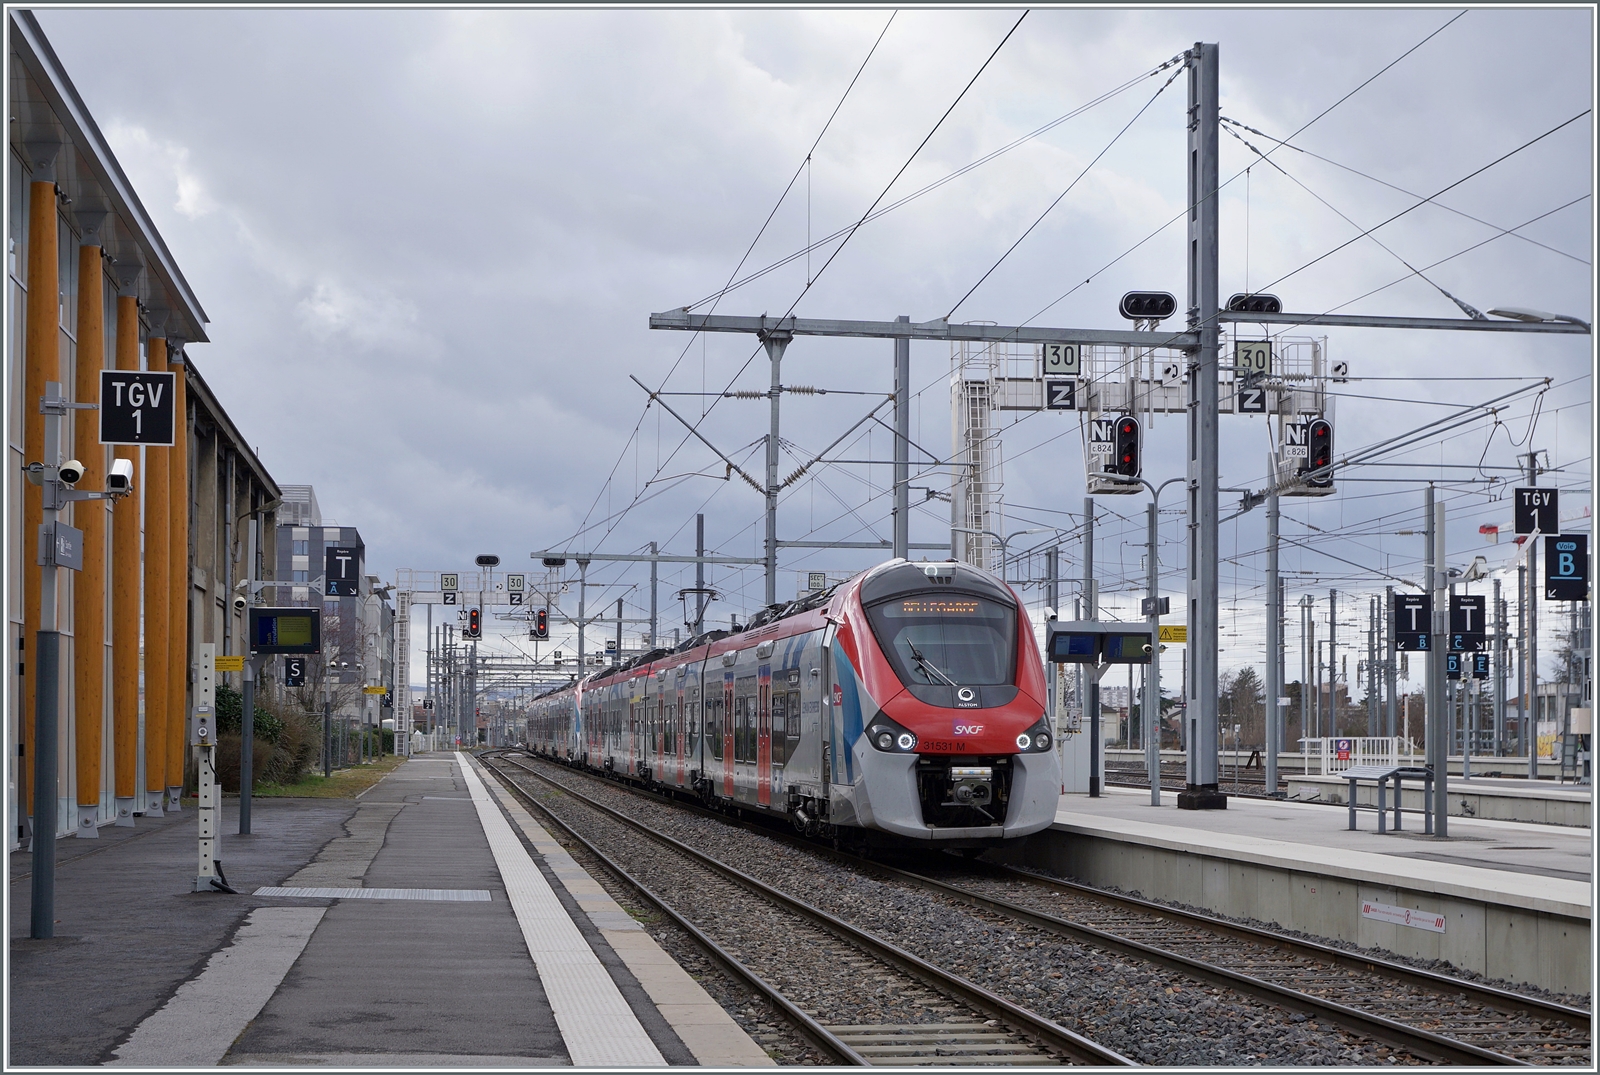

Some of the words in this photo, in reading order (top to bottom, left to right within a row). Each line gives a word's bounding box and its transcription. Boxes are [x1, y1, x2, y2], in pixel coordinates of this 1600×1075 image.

[1050, 345, 1074, 366] 30
[1242, 349, 1266, 370] 30
[111, 381, 164, 408] TGV
[1052, 385, 1071, 406] Z
[1243, 388, 1261, 409] Z
[131, 408, 142, 434] 1
[1091, 421, 1113, 441] Nf
[1286, 424, 1307, 445] Nf
[1522, 492, 1551, 506] TGV
[1529, 508, 1539, 529] 1
[335, 555, 352, 579] T
[1559, 552, 1576, 576] B
[330, 585, 338, 593] A
[443, 577, 456, 587] 30
[510, 578, 522, 588] 30
[445, 594, 454, 604] Z
[512, 594, 521, 604] Z
[1404, 604, 1423, 631] T
[1459, 605, 1478, 632] T
[1418, 639, 1427, 648] B
[1454, 639, 1463, 648] C
[290, 662, 301, 677] S
[1448, 660, 1457, 670] D
[1478, 661, 1485, 670] E
[384, 692, 391, 700] R
[954, 725, 984, 735] SNCF
[923, 741, 953, 751] 31531
[956, 742, 966, 751] M
